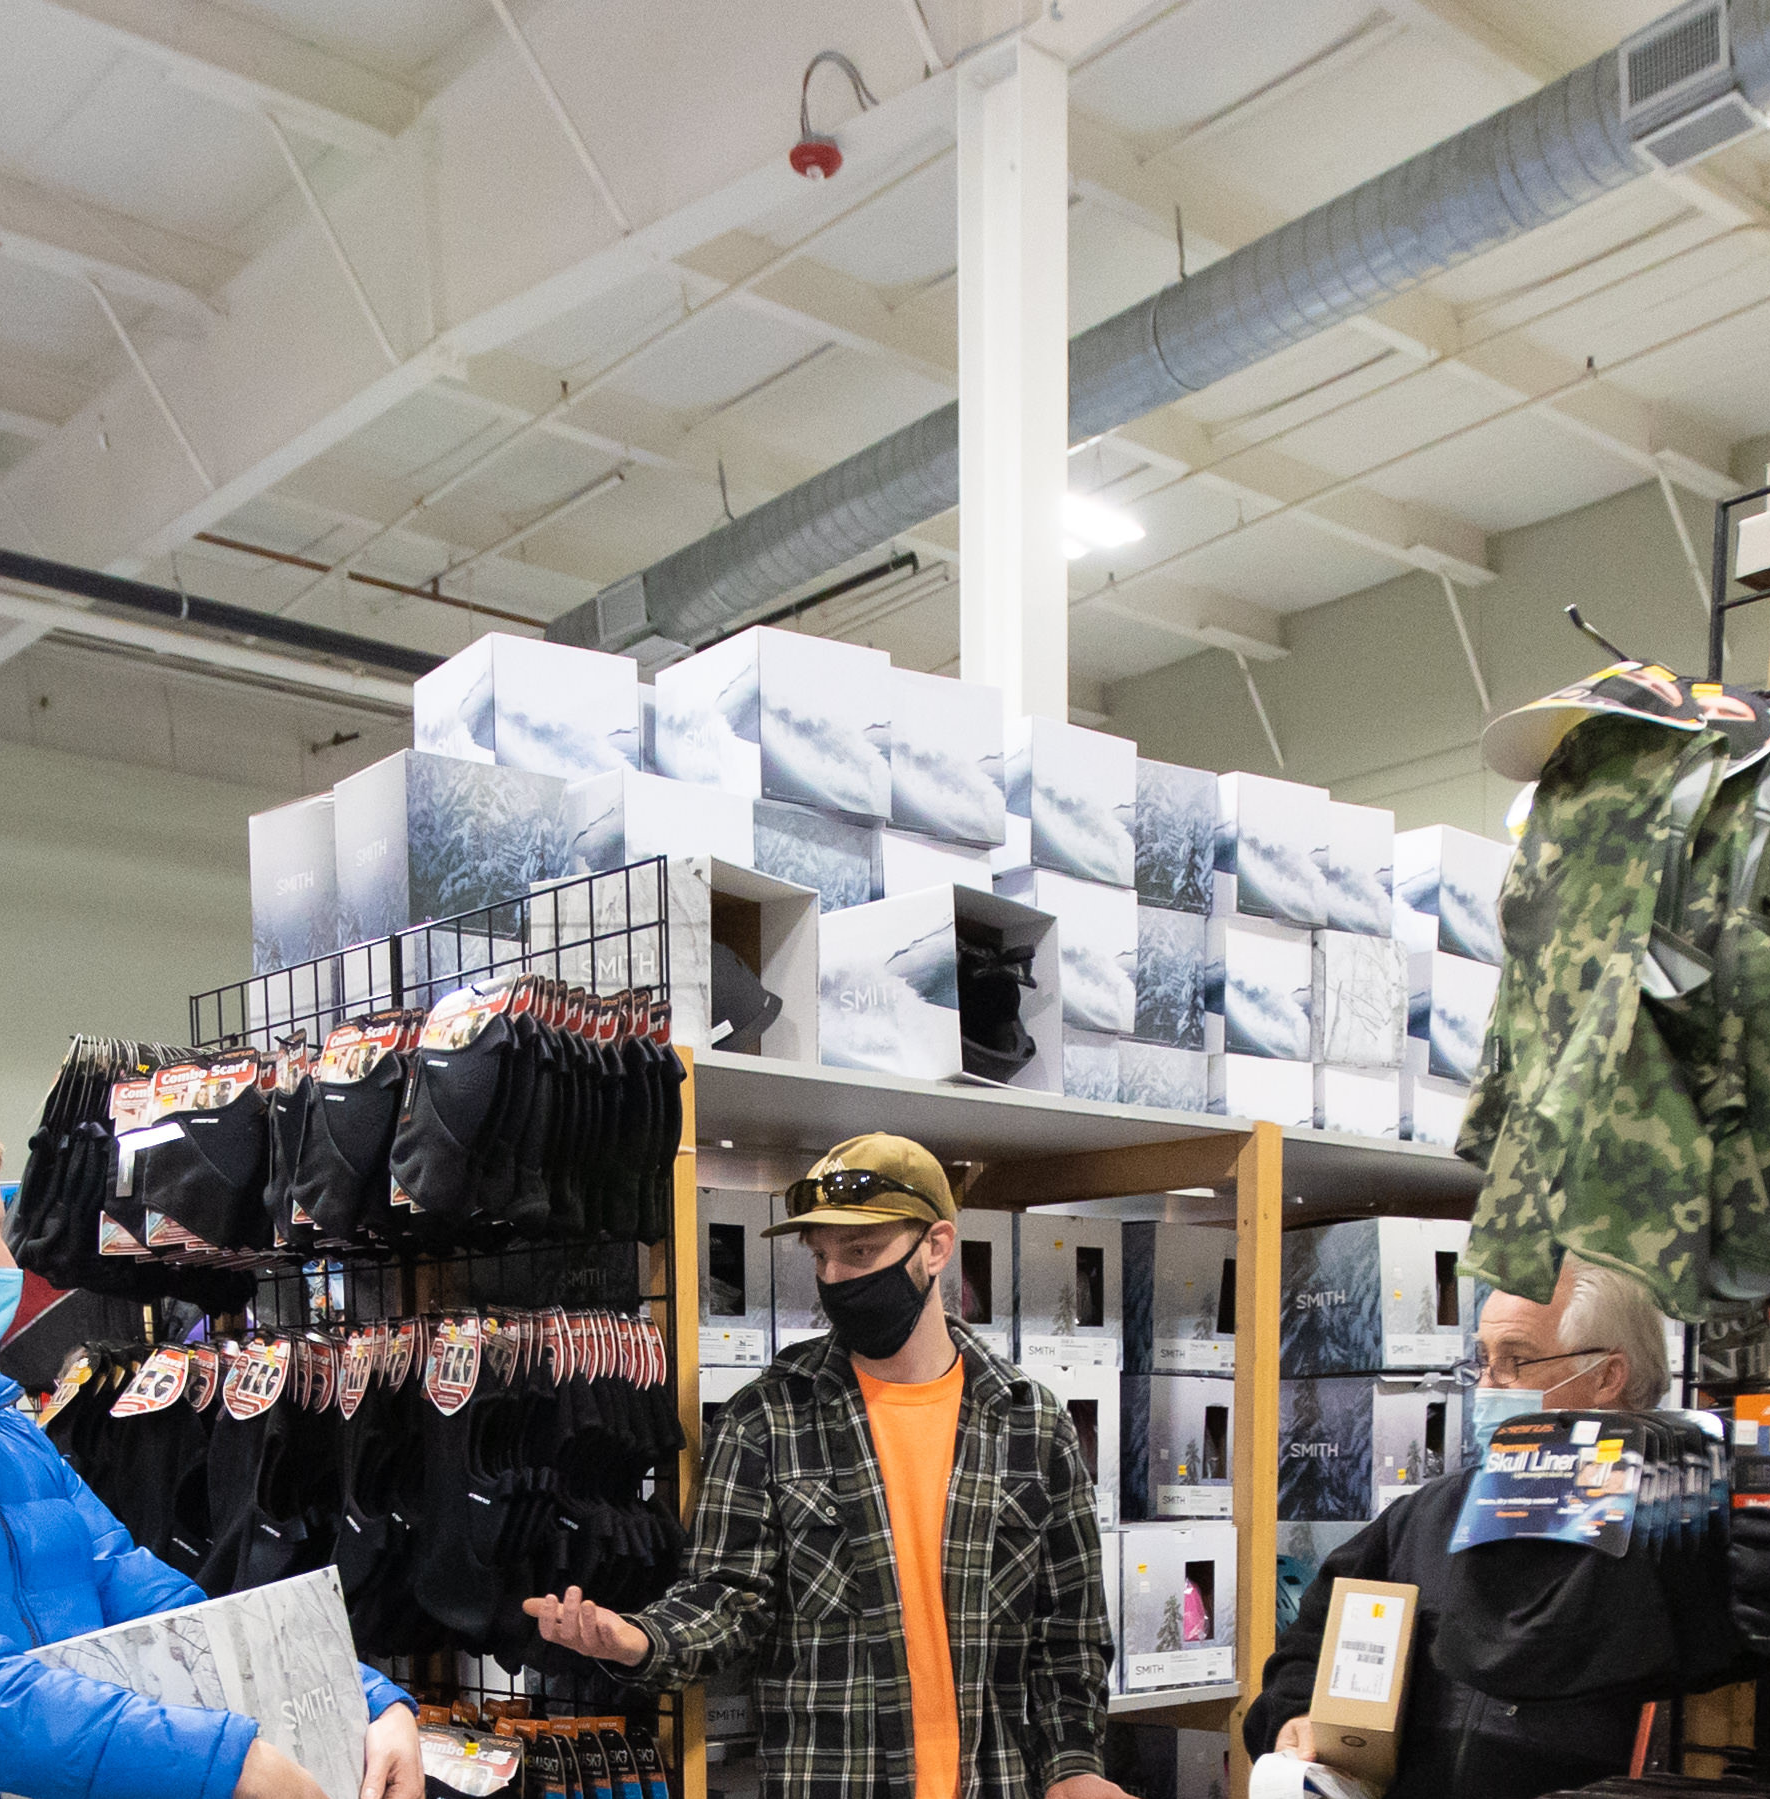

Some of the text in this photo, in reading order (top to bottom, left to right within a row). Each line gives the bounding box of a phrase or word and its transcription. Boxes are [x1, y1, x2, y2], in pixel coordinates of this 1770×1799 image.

[355, 837, 388, 867] SMITH
[276, 869, 314, 896] SMITH
[581, 951, 656, 983] SMITH
[364, 1021, 398, 1042] Scarf
[160, 1058, 249, 1086] Combo Scarf
[120, 1086, 151, 1099] Com
[1296, 1289, 1346, 1310] SMITH
[1028, 1343, 1056, 1357] SMITH
[1160, 1347, 1186, 1361] SMITH
[1289, 1442, 1339, 1458] SMITH
[1485, 1451, 1580, 1473] Skull Liner
[1135, 1663, 1166, 1677] SMITH
[280, 1683, 336, 1732] SMITH
[707, 1708, 746, 1723] SMITH
